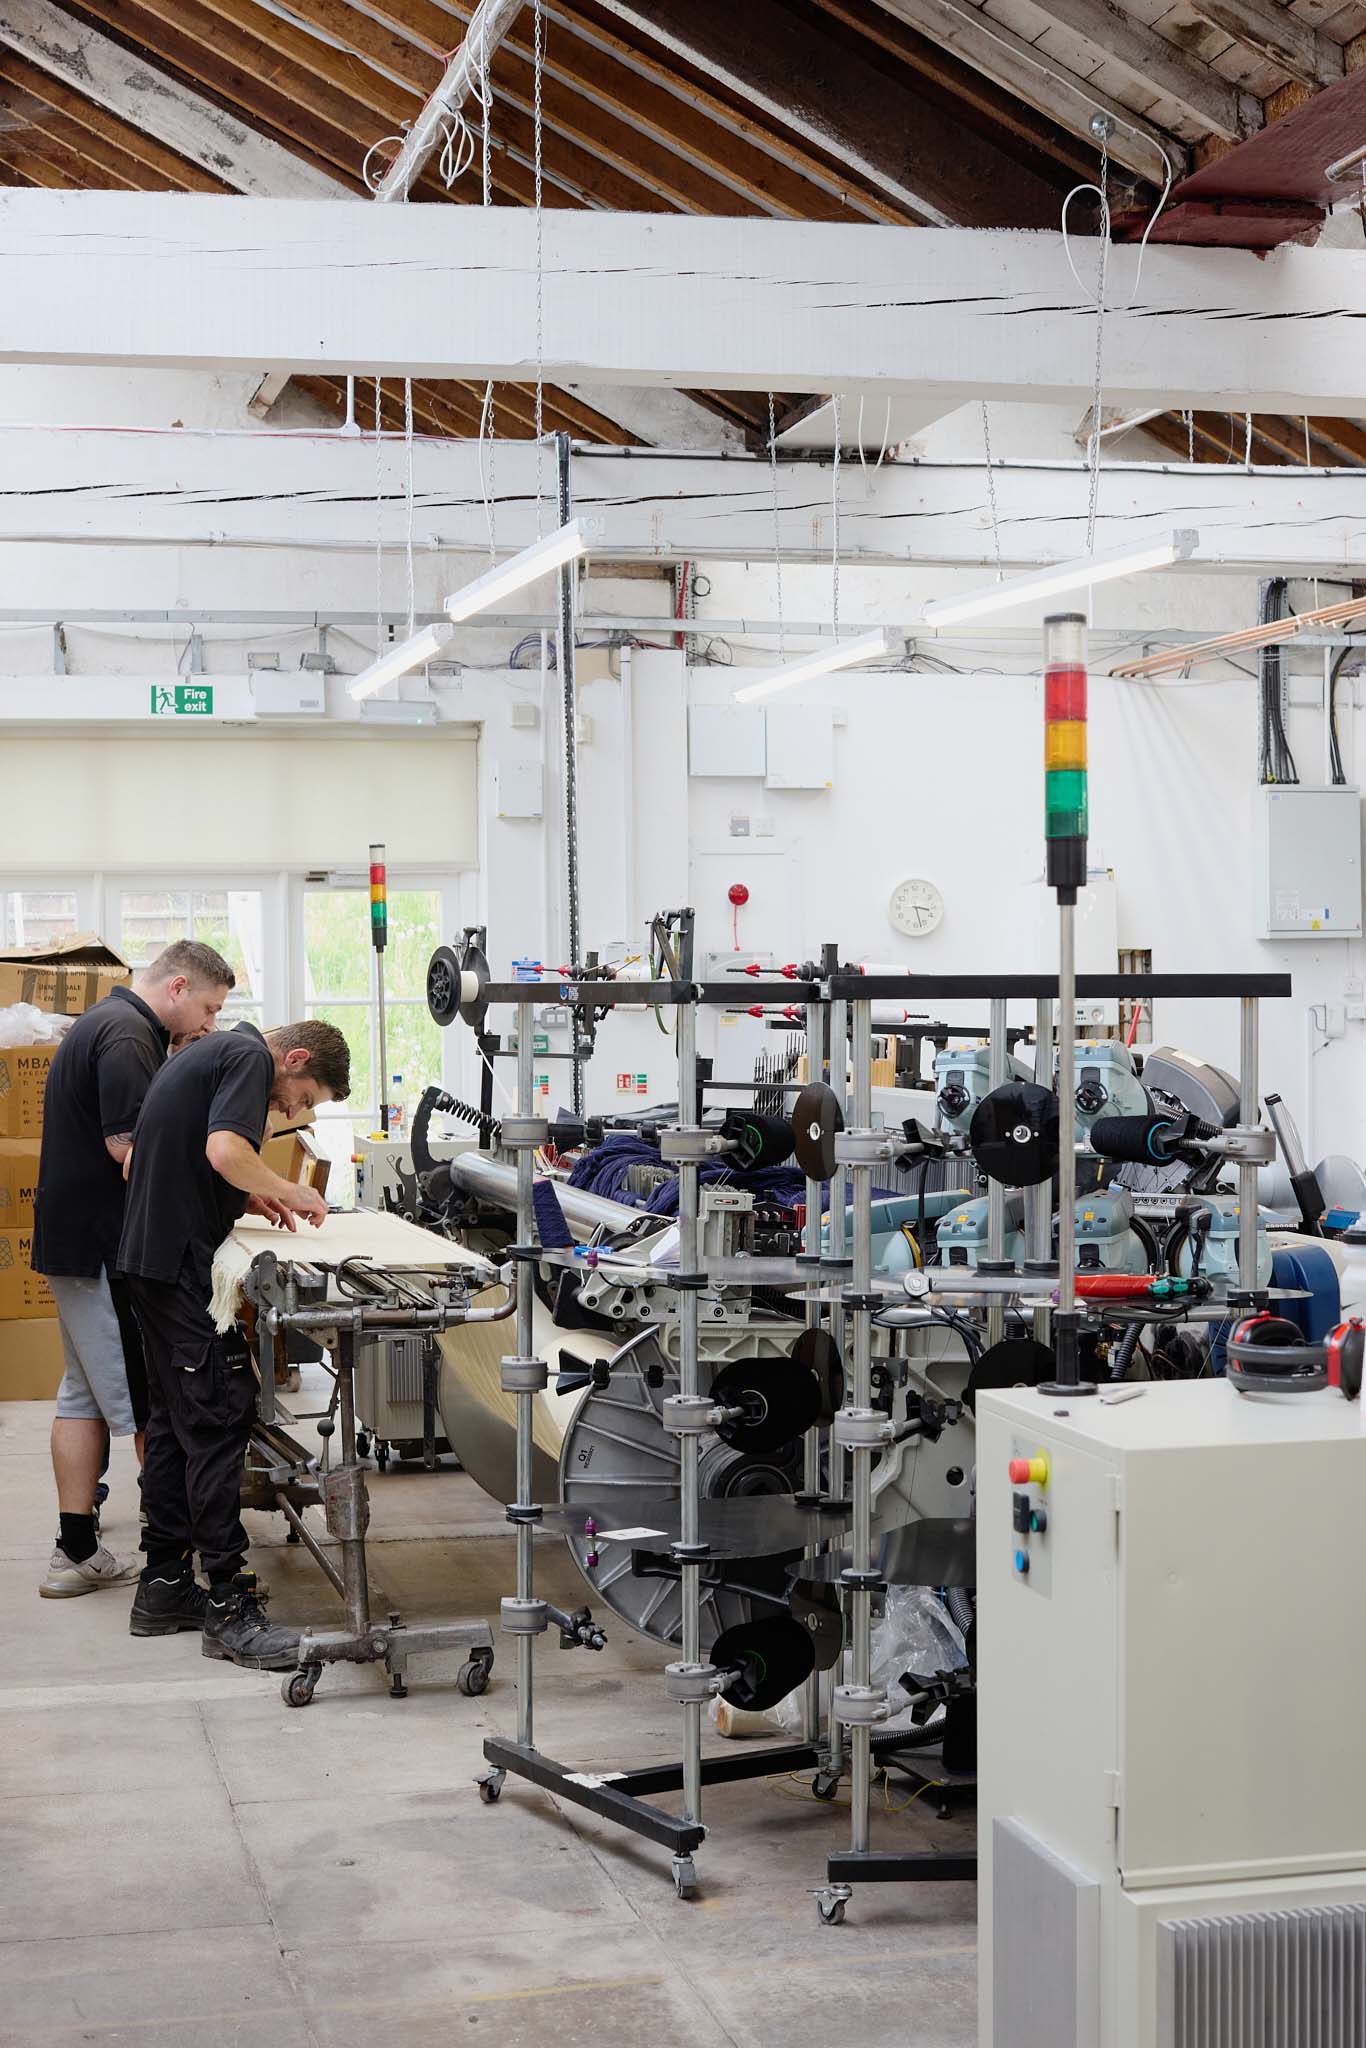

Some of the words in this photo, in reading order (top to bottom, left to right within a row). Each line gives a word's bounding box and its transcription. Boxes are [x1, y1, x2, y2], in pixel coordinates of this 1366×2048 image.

[184, 689, 207, 700] Fire
[184, 701, 207, 711] exit
[578, 1449, 588, 1461] Q1
